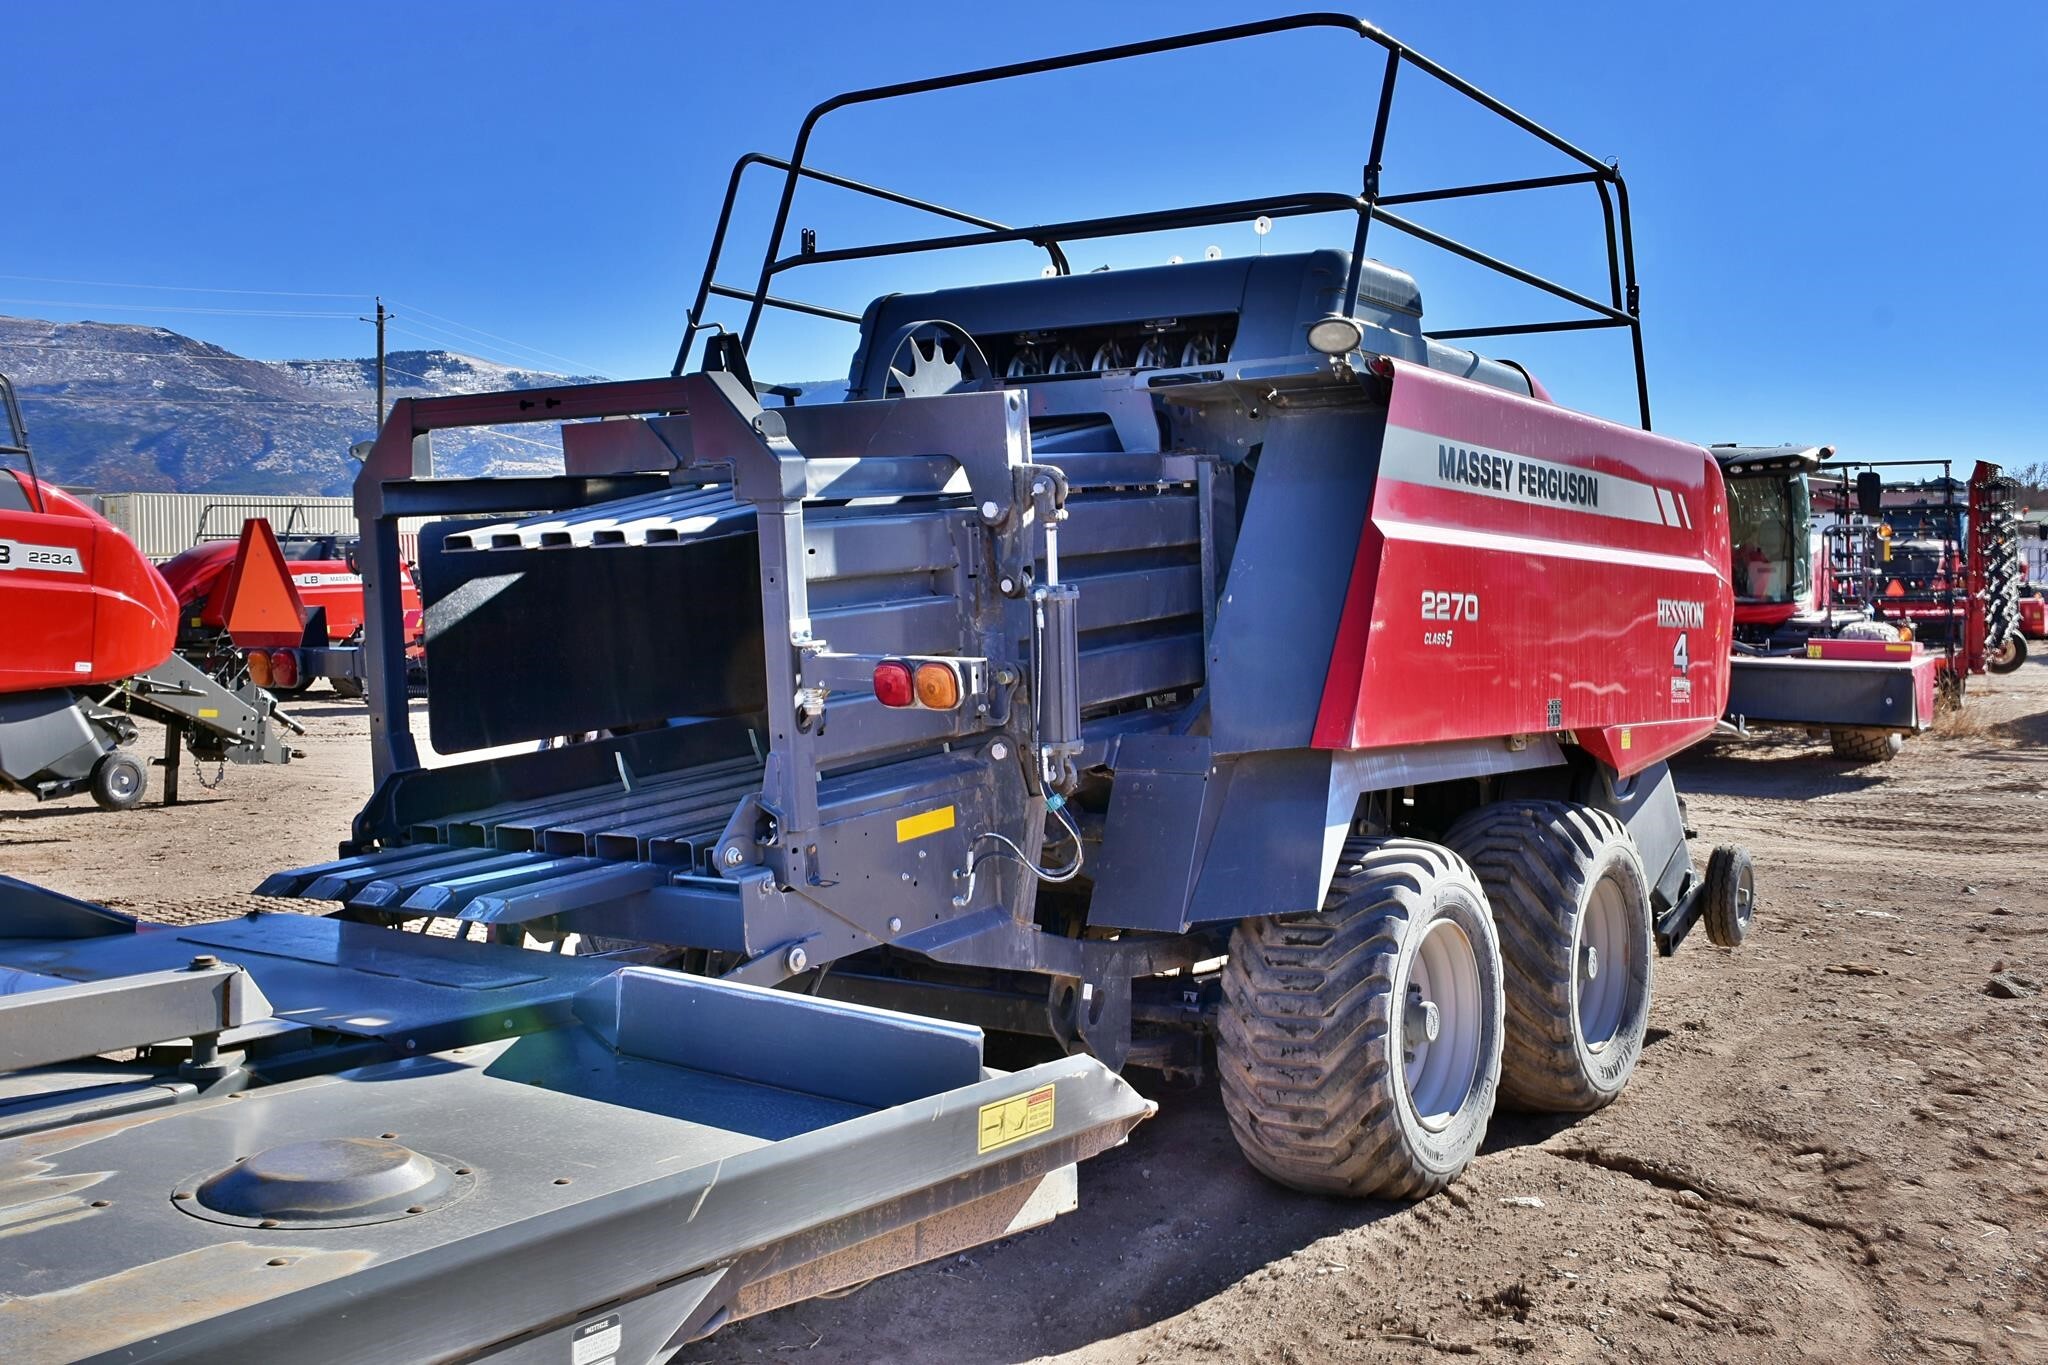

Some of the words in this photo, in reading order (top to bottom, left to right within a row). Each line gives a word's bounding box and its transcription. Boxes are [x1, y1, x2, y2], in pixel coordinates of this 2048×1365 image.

[1438, 444, 1513, 492] MASSEY
[1518, 462, 1599, 507] FERGUSON
[28, 552, 73, 566] 2234
[304, 575, 319, 584] LB
[1421, 590, 1479, 621] 2270
[1657, 598, 1704, 629] HESSTON
[1424, 632, 1446, 645] CLASS
[1446, 629, 1453, 648] 5
[1673, 631, 1689, 676] 4
[585, 1320, 609, 1335] NOTICE
